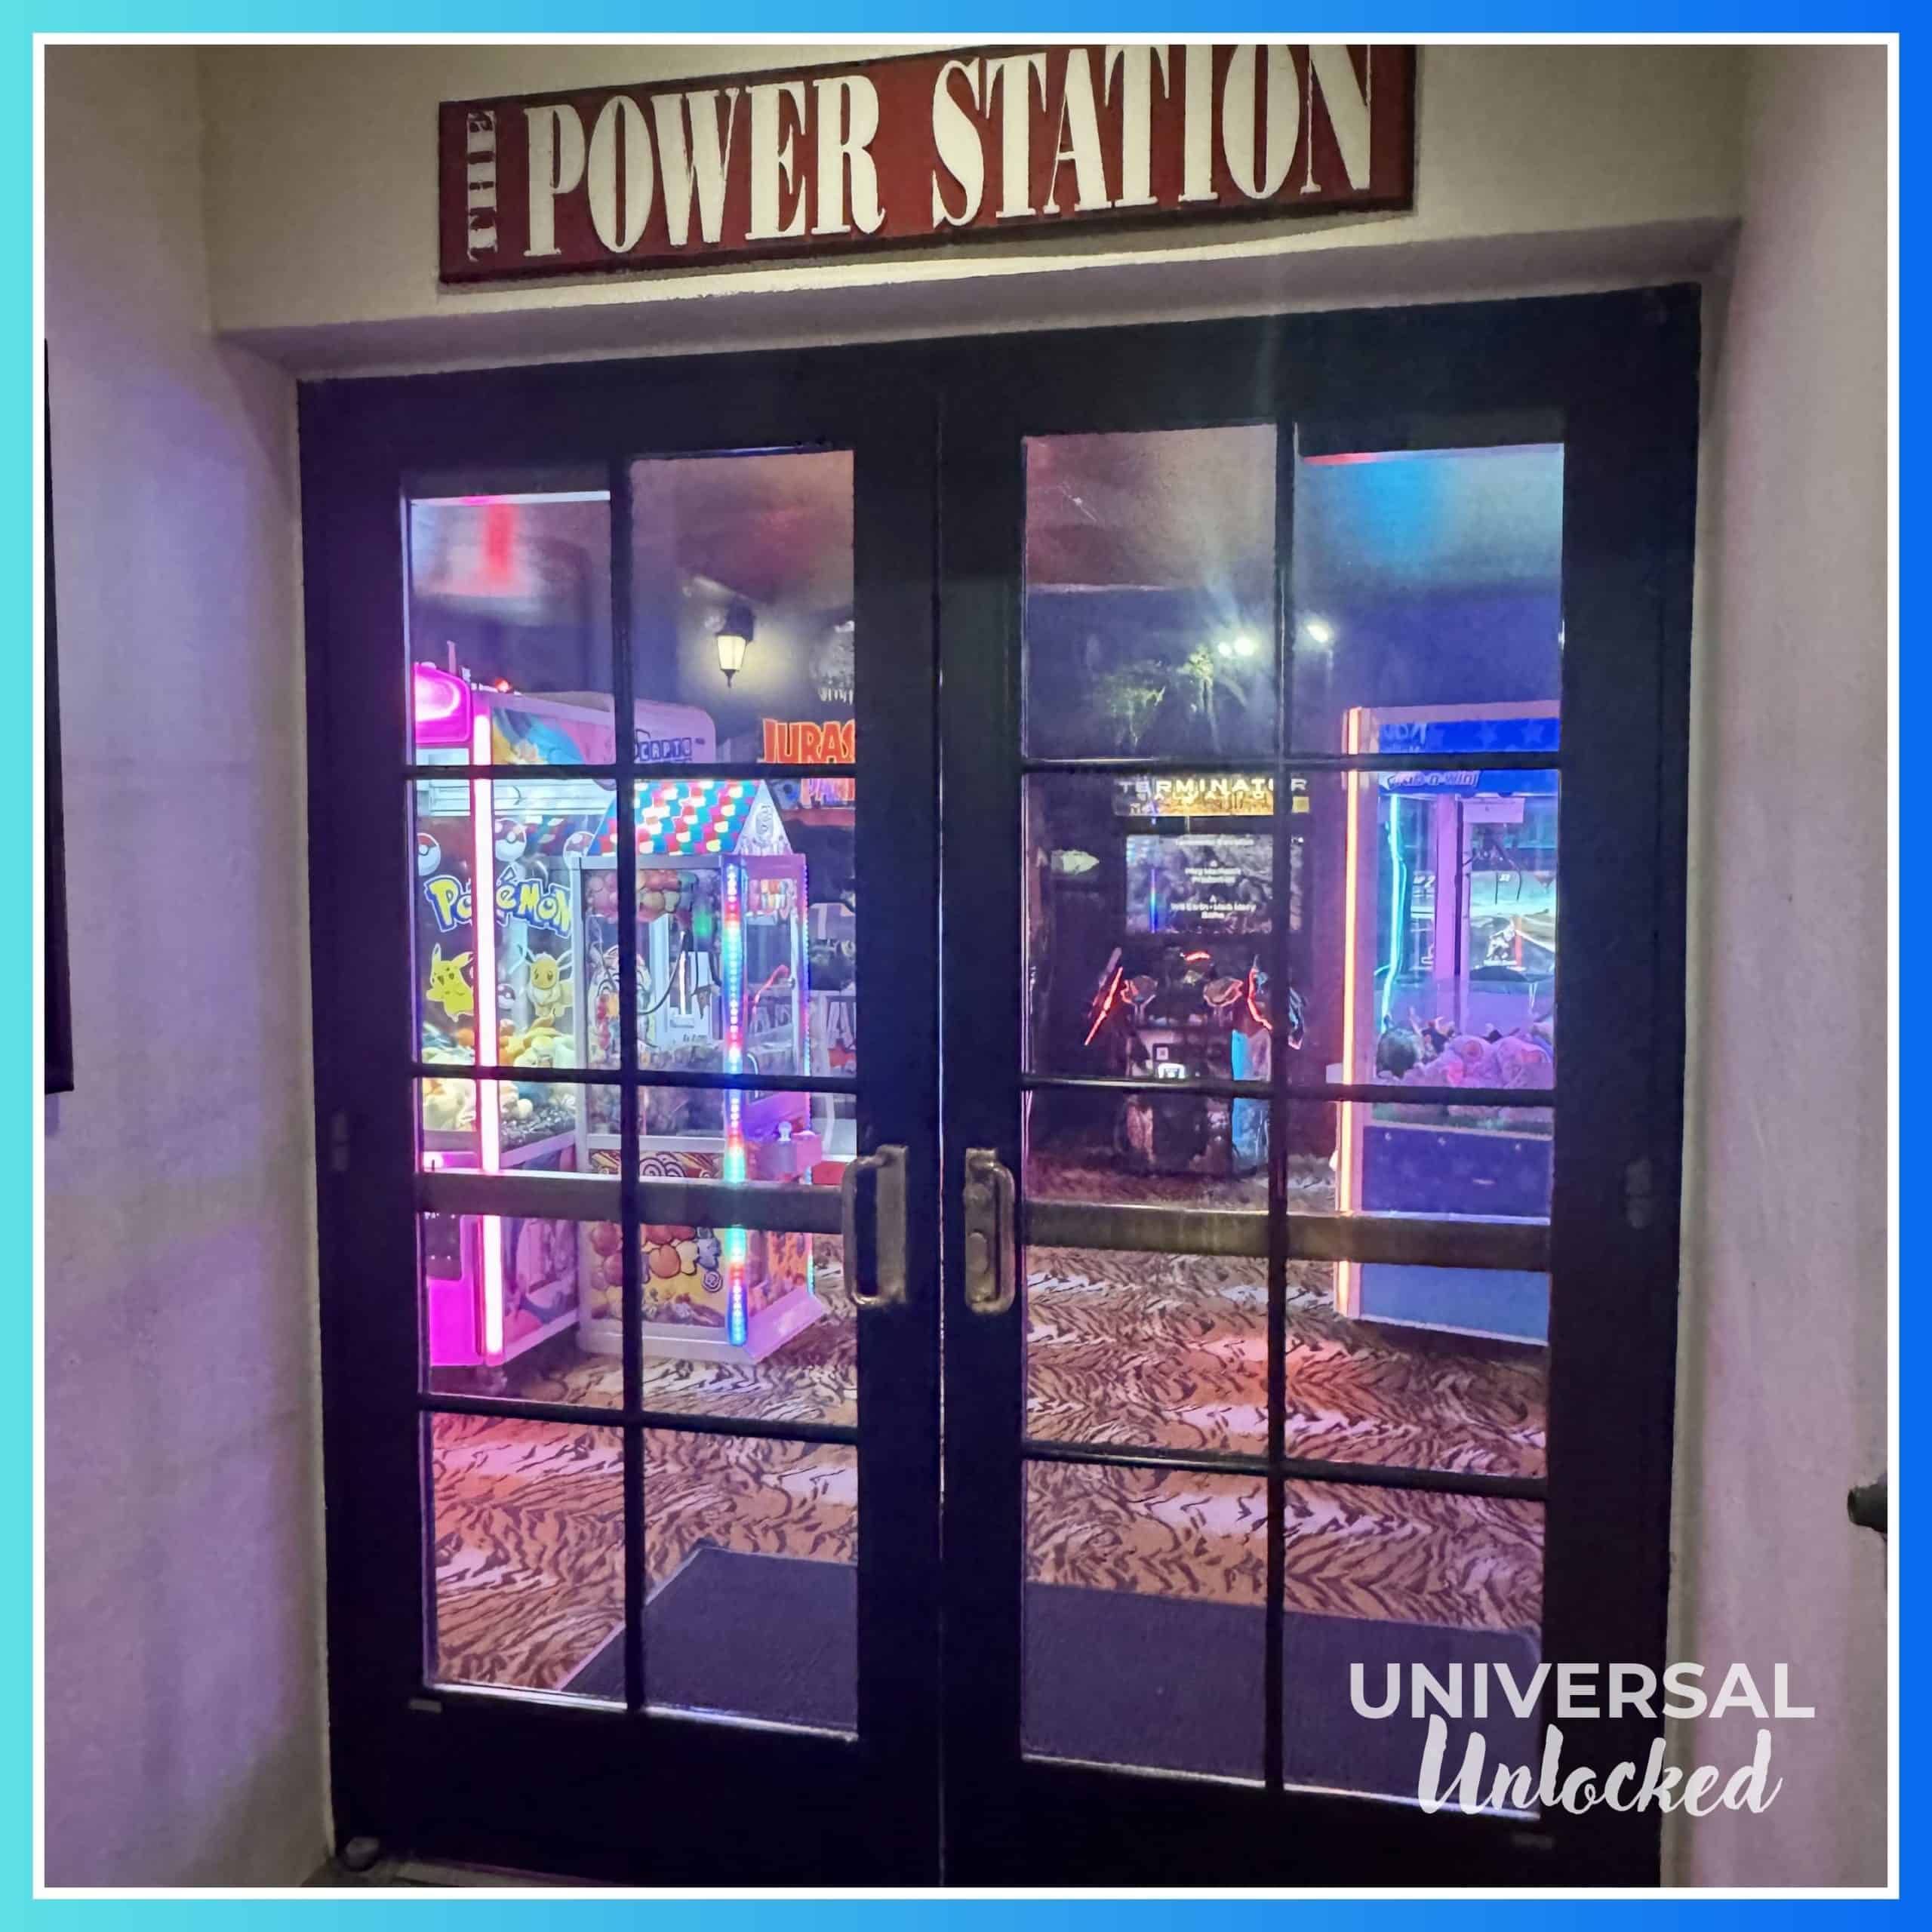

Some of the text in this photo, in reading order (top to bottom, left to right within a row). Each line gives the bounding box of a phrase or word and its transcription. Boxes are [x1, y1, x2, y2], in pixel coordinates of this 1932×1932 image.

[466, 45, 1371, 262] THE POWER STATION
[1119, 777, 1307, 793] TERMINATR
